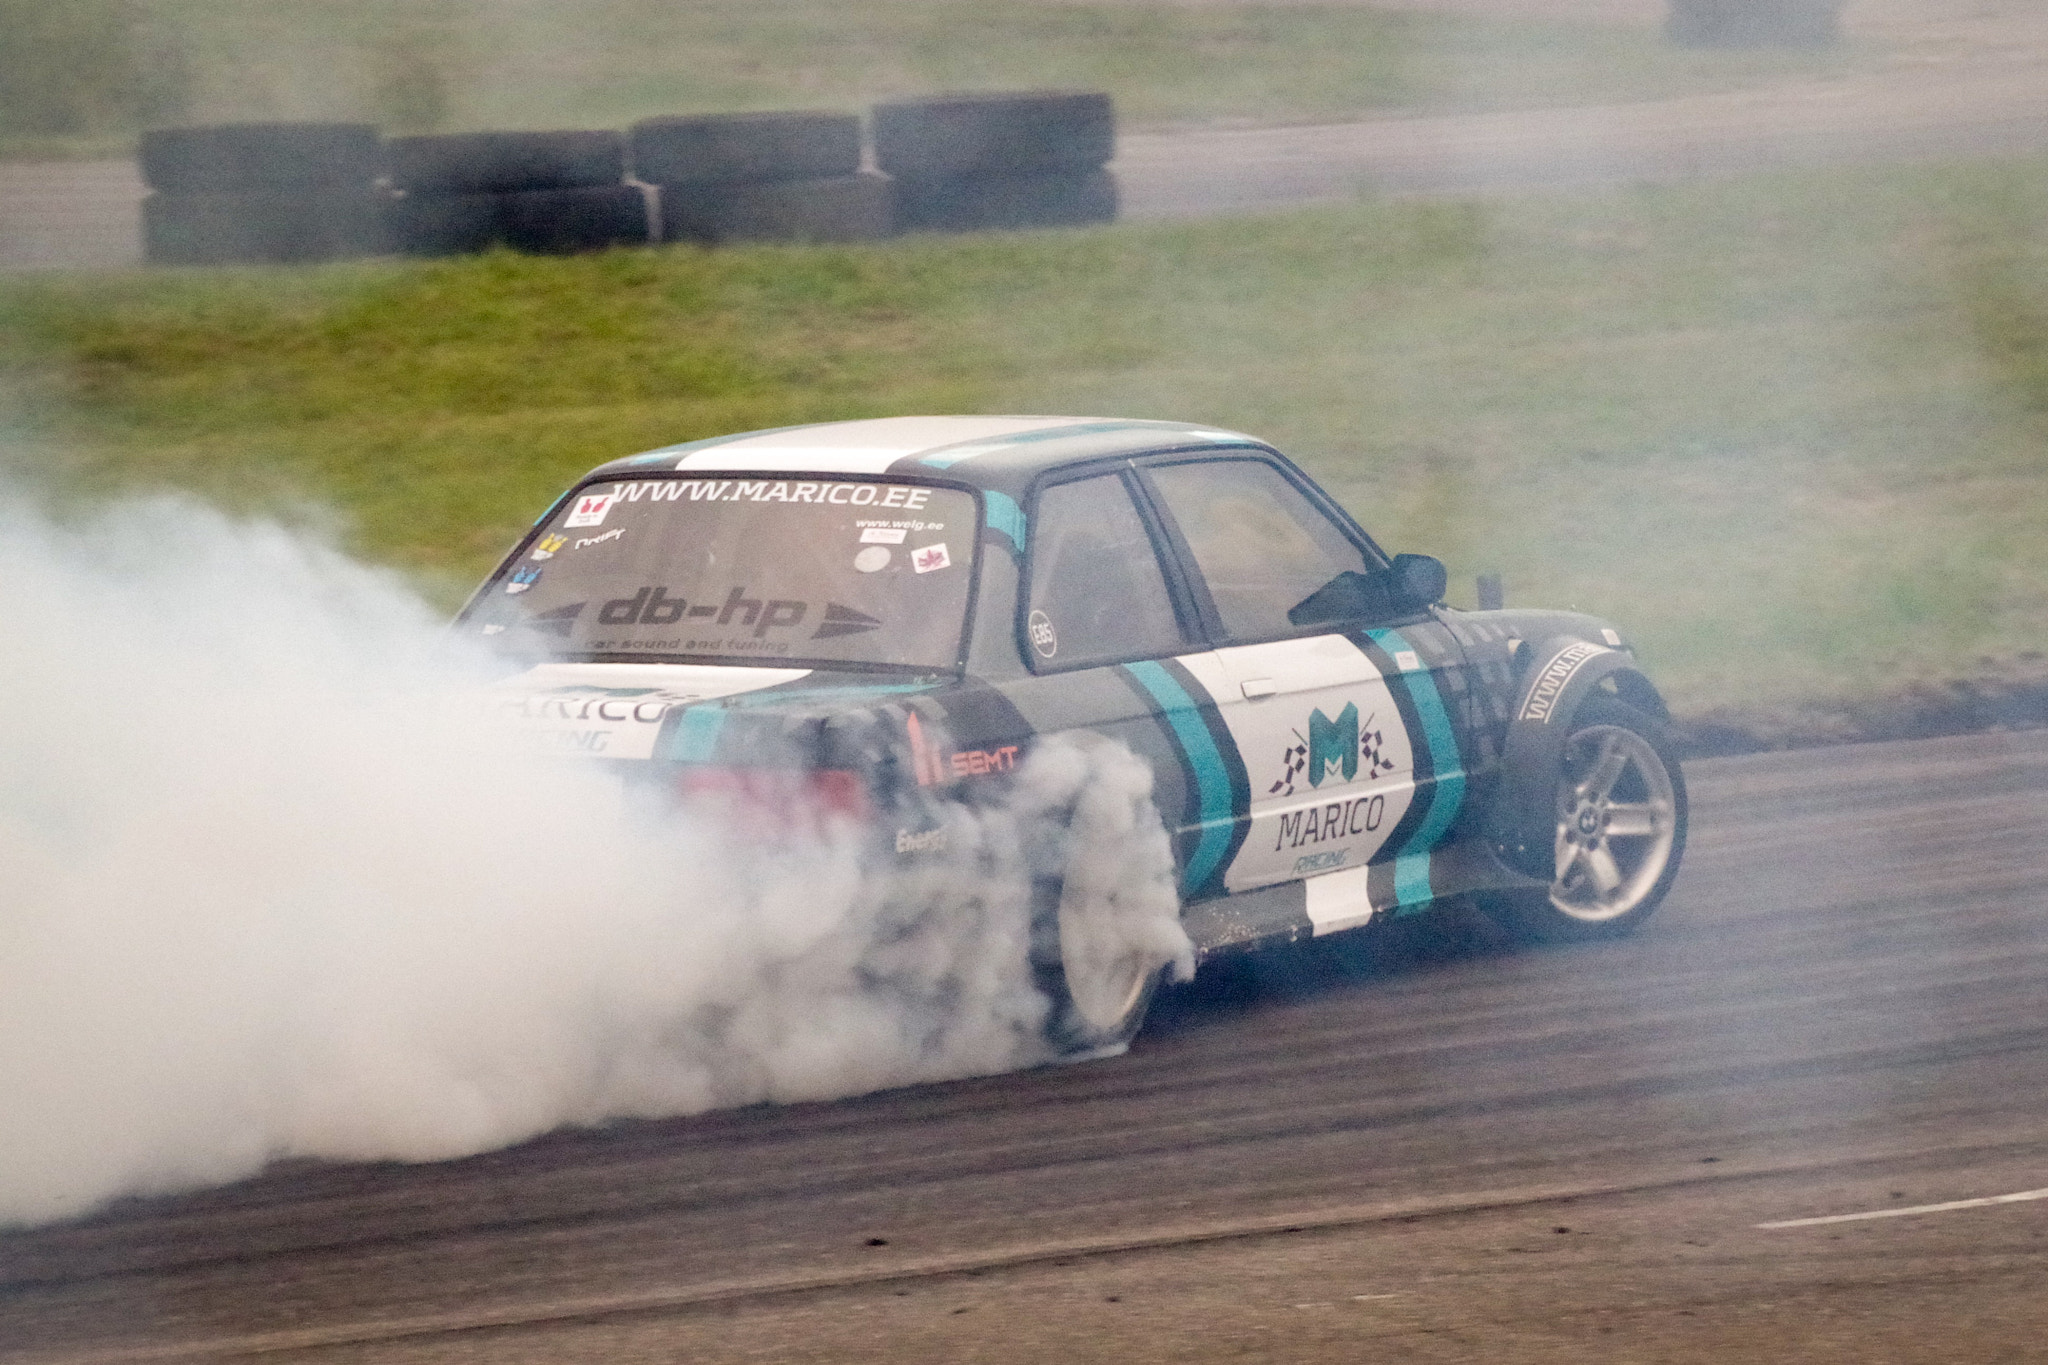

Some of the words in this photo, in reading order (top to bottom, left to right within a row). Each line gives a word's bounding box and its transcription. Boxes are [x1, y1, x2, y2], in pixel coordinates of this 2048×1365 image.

[613, 481, 932, 510] WWW.MARICO.EE
[598, 587, 808, 638] db-hp
[621, 638, 681, 651] sound
[686, 639, 721, 651] and
[726, 638, 789, 653] tuning
[1275, 794, 1385, 852] MARICO
